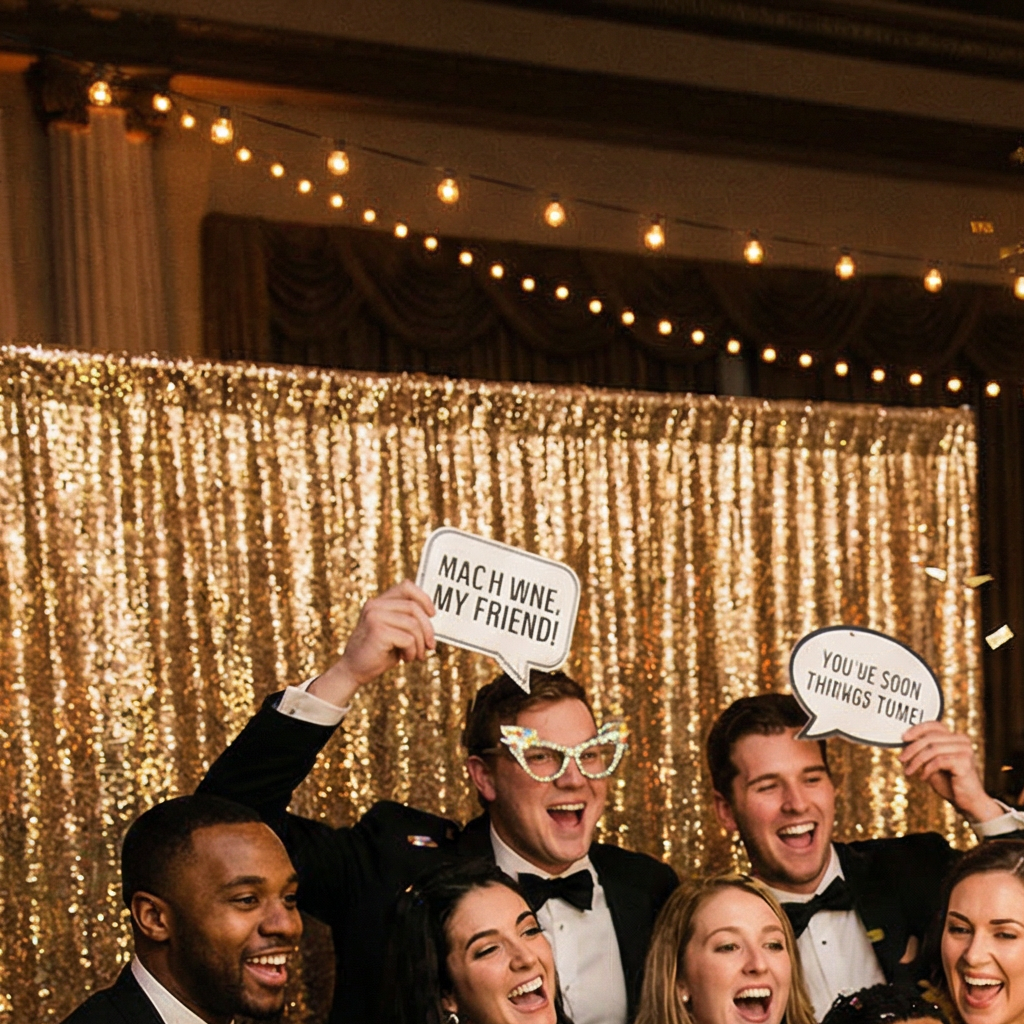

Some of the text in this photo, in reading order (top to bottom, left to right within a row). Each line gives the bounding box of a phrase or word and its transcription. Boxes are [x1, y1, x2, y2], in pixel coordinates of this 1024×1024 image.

[433, 584, 559, 646] MY FRIEND!
[880, 671, 922, 700] SOON
